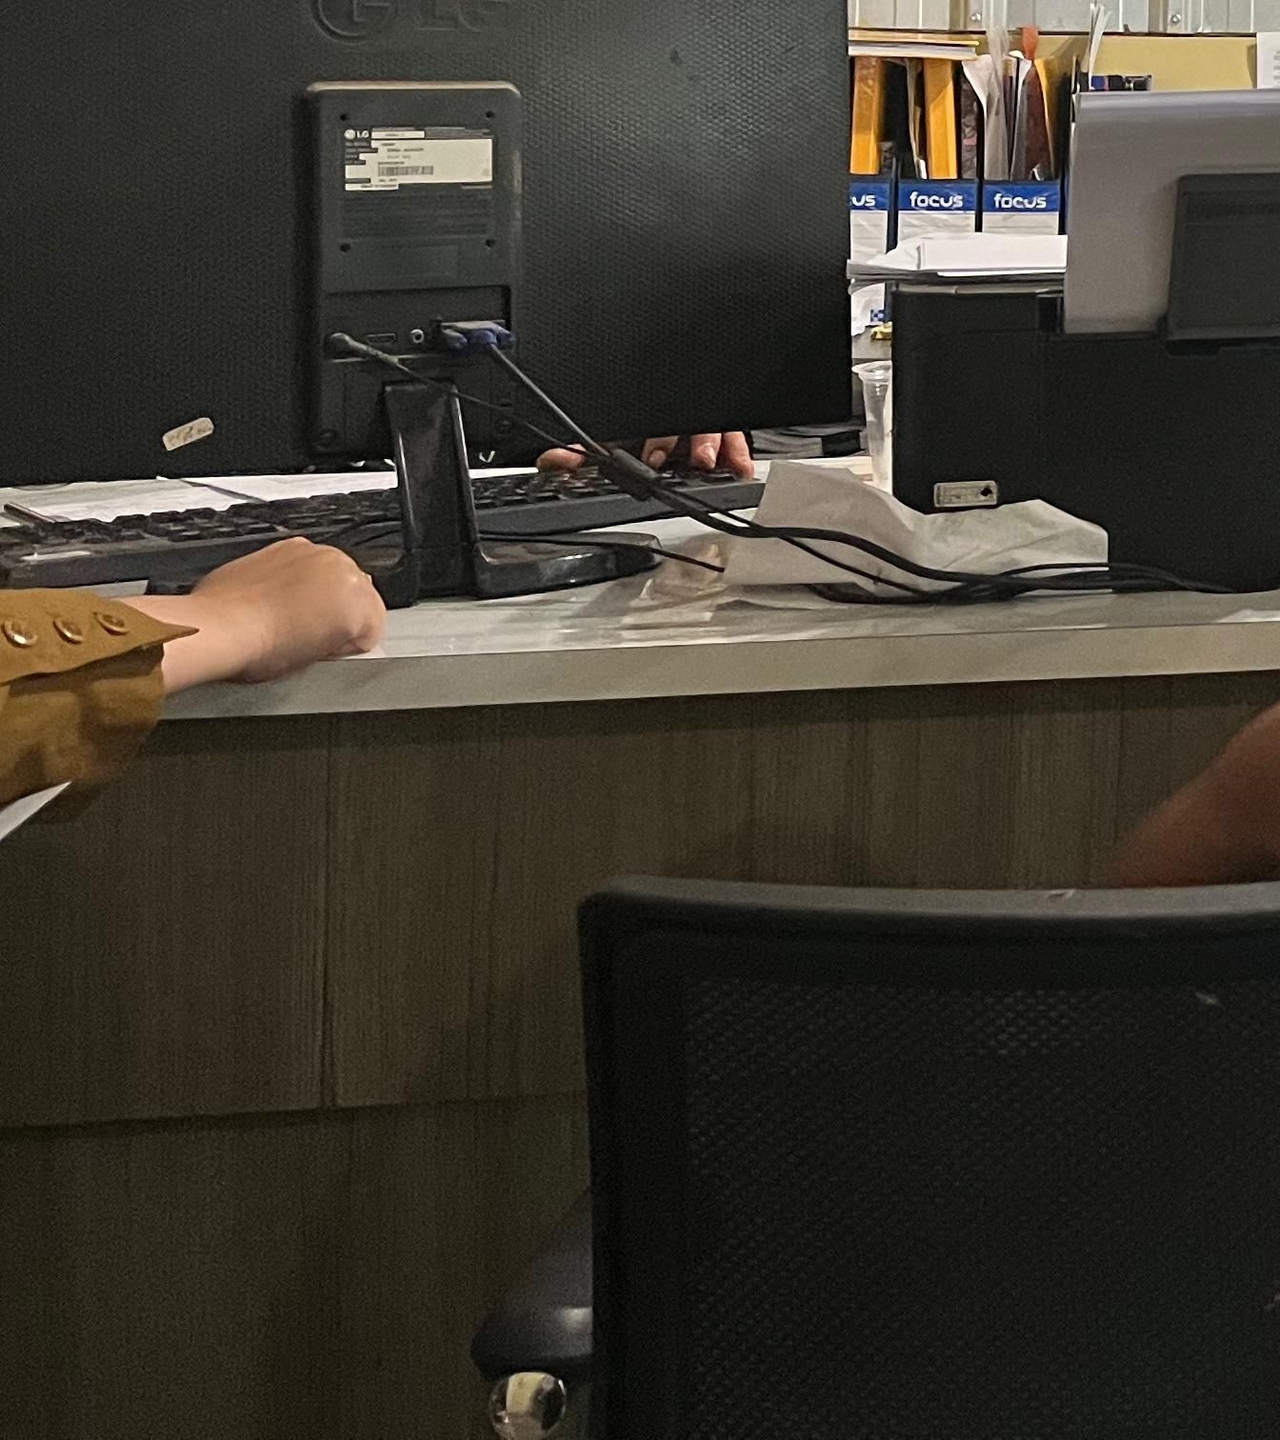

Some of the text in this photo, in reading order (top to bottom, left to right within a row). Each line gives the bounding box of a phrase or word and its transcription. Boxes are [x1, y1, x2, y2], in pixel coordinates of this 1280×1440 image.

[356, 130, 370, 139] LG
[909, 190, 964, 208] focus
[993, 192, 1047, 209] focus
